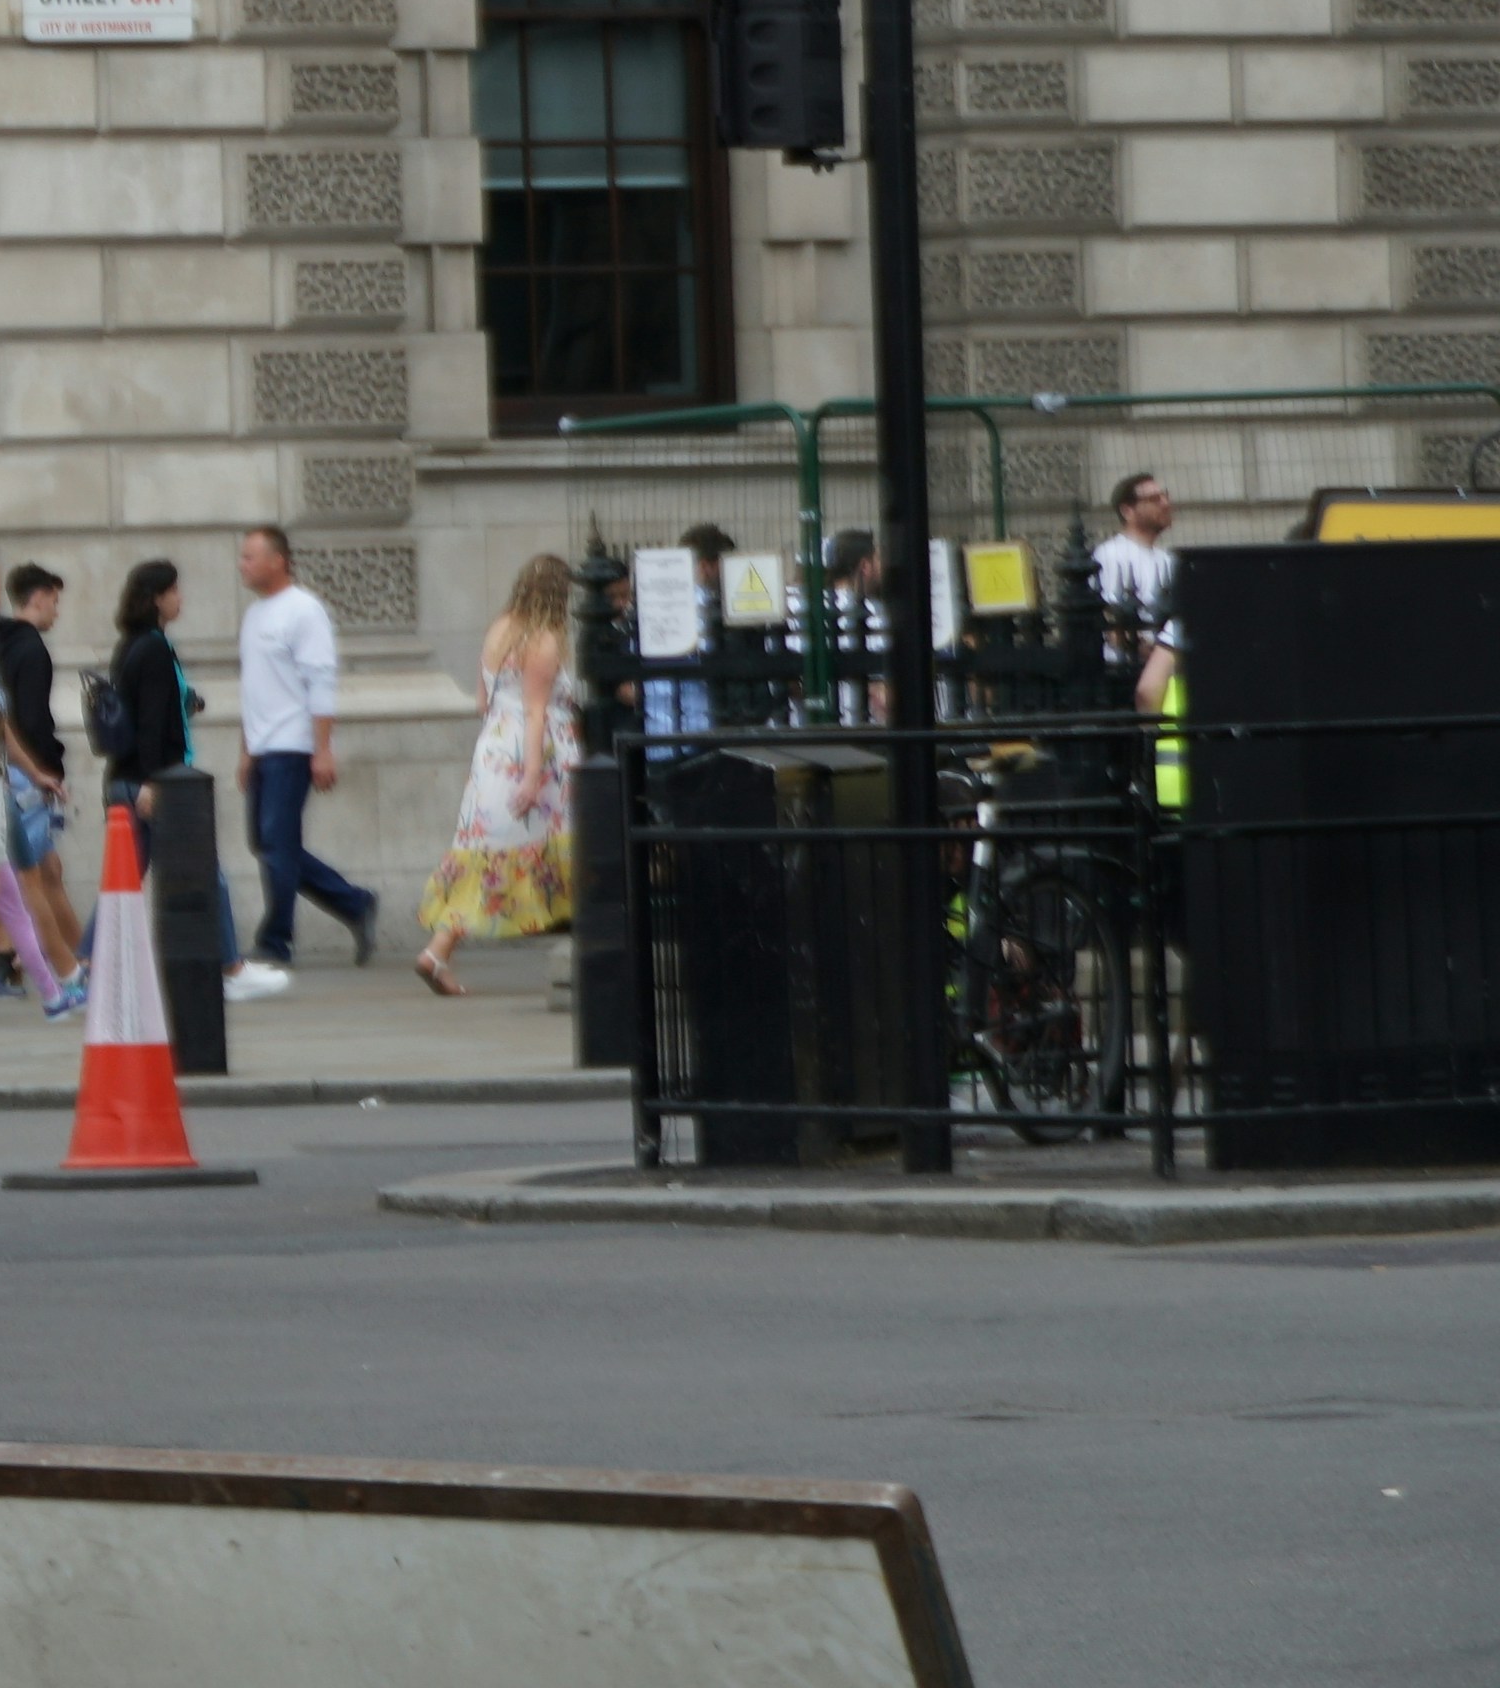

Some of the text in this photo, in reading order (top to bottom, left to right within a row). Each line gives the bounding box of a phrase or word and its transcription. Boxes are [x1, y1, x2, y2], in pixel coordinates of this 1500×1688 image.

[39, 21, 152, 34] CITY OF WESTMINSTER
